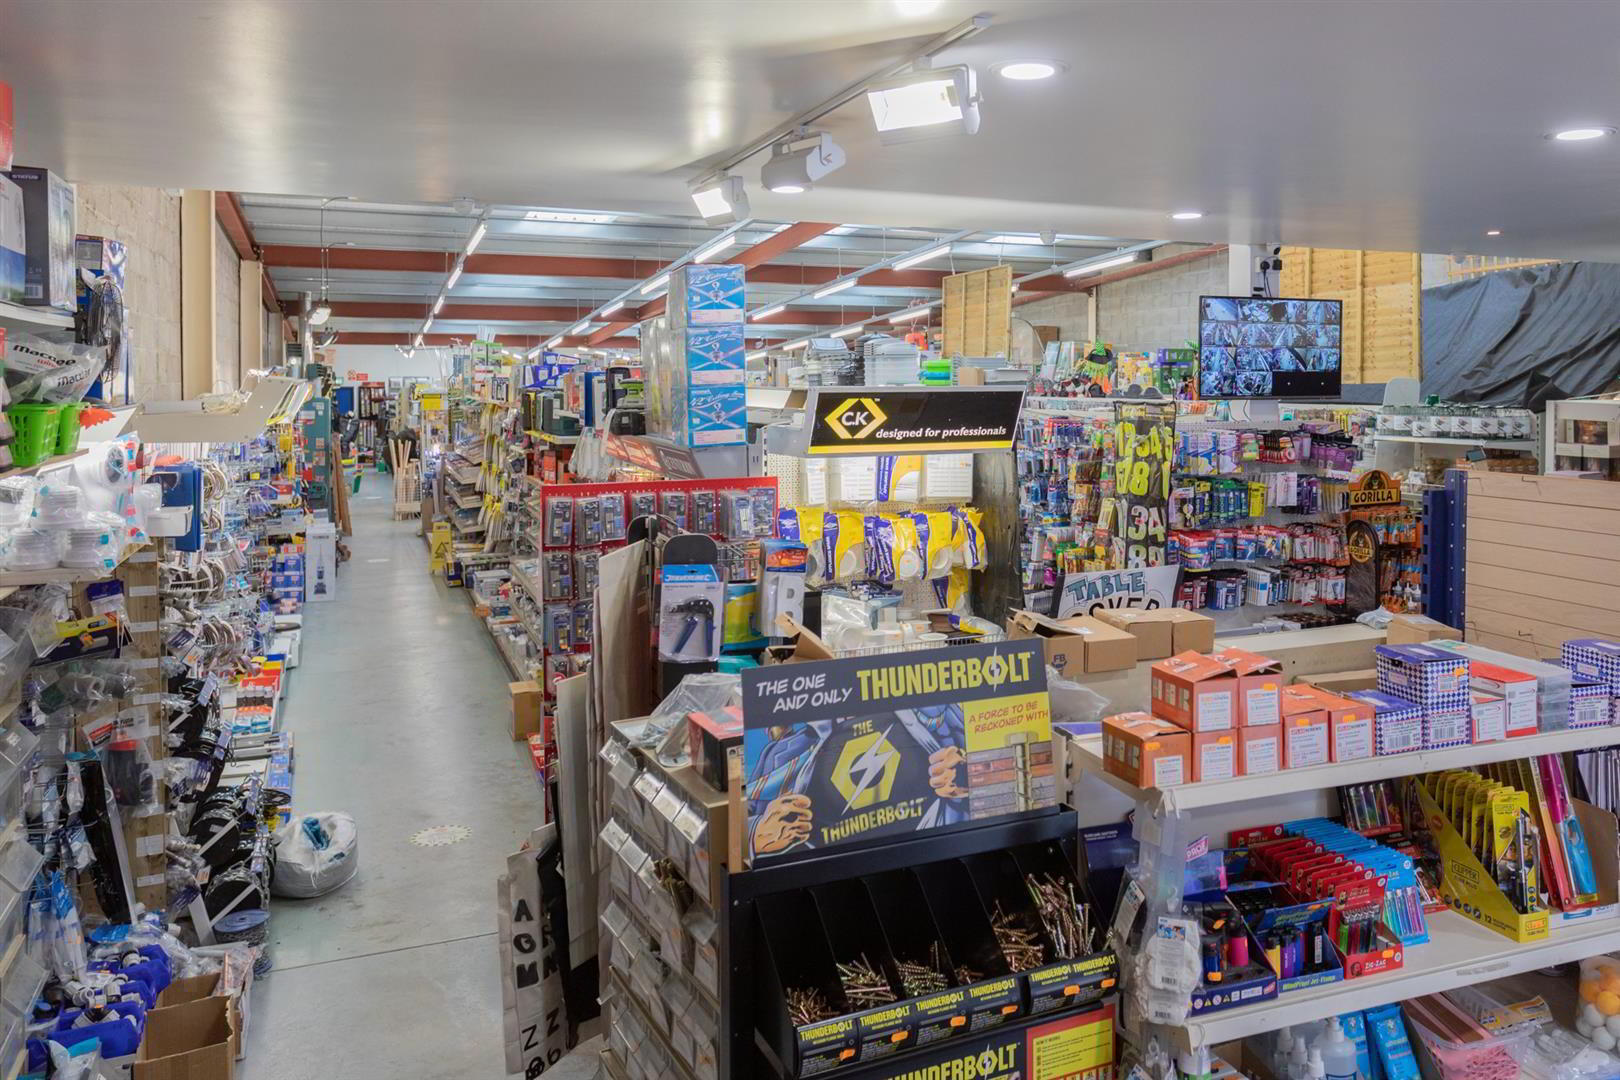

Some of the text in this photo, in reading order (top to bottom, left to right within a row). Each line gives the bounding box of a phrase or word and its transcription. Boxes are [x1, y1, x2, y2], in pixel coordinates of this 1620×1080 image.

[876, 425, 1007, 440] designed for professionals
[1354, 490, 1393, 502] GORILLA
[1066, 571, 1145, 601] TABLE
[756, 673, 826, 697] THE ONE
[857, 648, 1033, 701] THUNDERBOLT
[773, 687, 852, 713] AND ONLY
[968, 701, 1038, 724] A FORCE TO BE
[974, 709, 1050, 734] RECKONED WITH
[852, 720, 874, 737] THE
[821, 797, 925, 844] THUNDERBOLT
[1453, 863, 1479, 880] CLIPPER
[1484, 914, 1492, 923] 12
[1073, 954, 1116, 973] THUNDERBOLT
[969, 978, 1016, 998] THUNDERBOLT
[916, 991, 965, 1011] THUNDERBOLT
[860, 1005, 911, 1027] THUNDERBOLT
[800, 1020, 853, 1041] THUNDERBOLT
